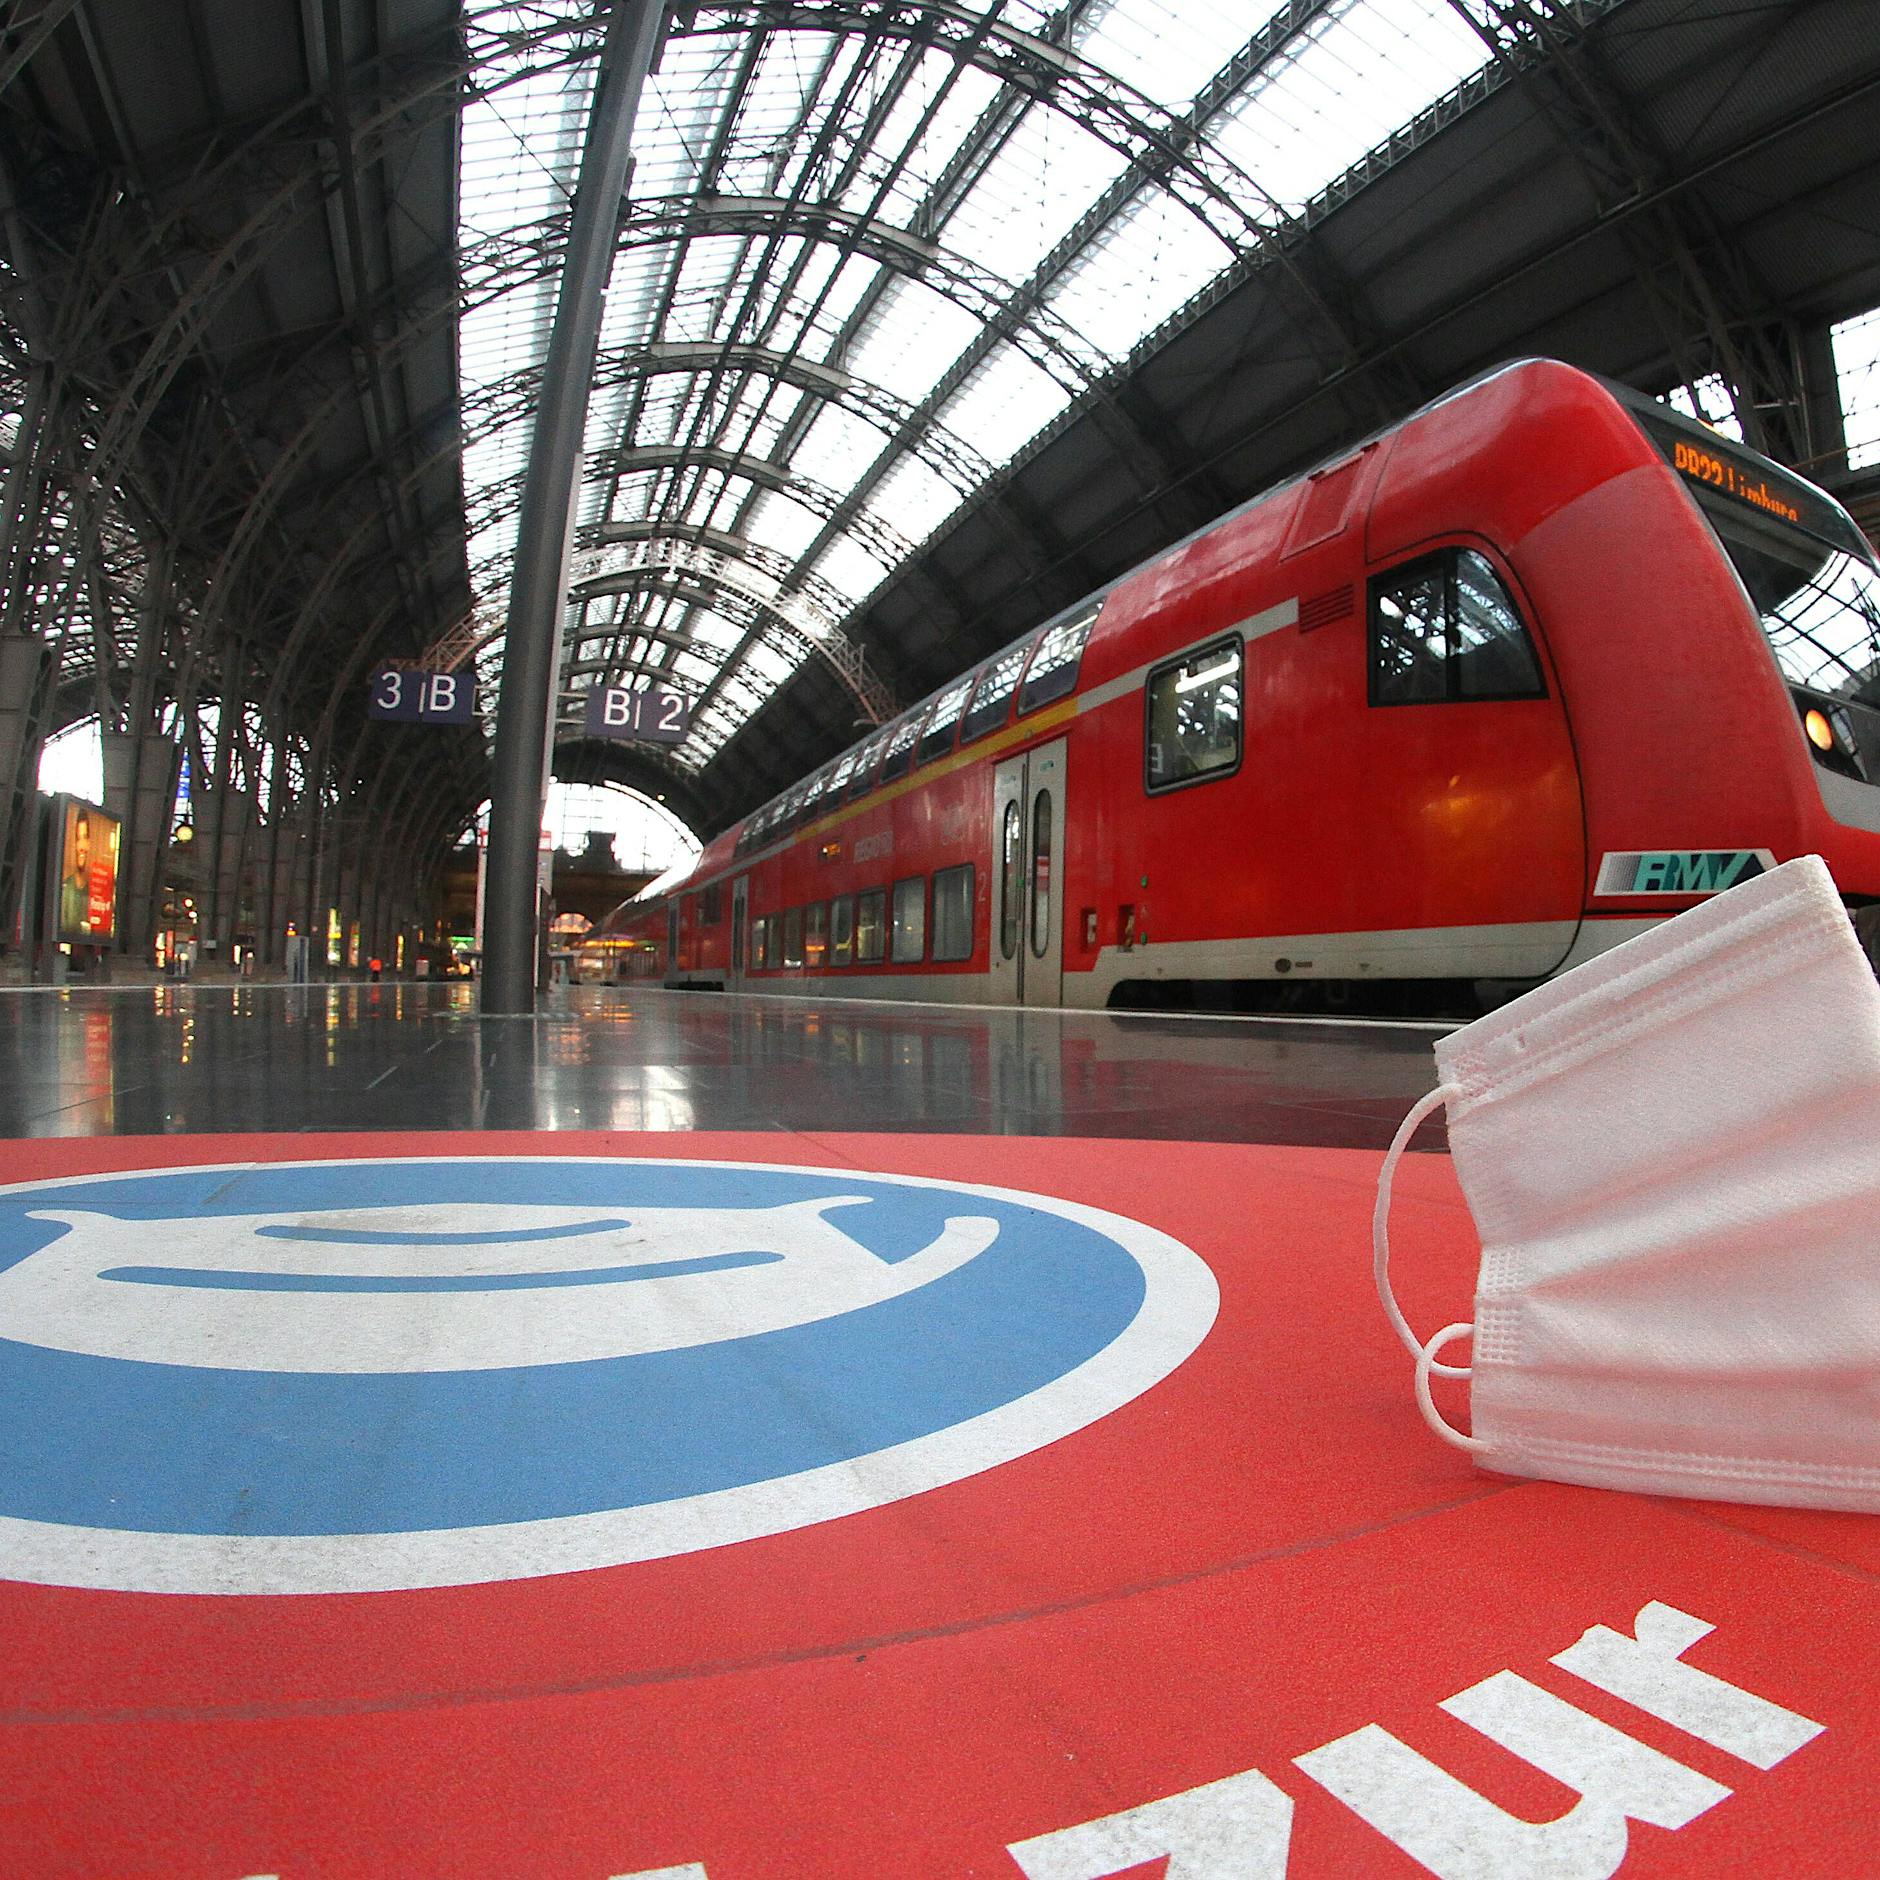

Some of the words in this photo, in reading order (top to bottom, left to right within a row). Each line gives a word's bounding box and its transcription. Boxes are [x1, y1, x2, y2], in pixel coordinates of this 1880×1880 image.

[376, 671, 402, 709] 3
[428, 674, 457, 712] B
[603, 689, 631, 727] B
[658, 694, 682, 732] 2
[1631, 852, 1752, 892] RMV
